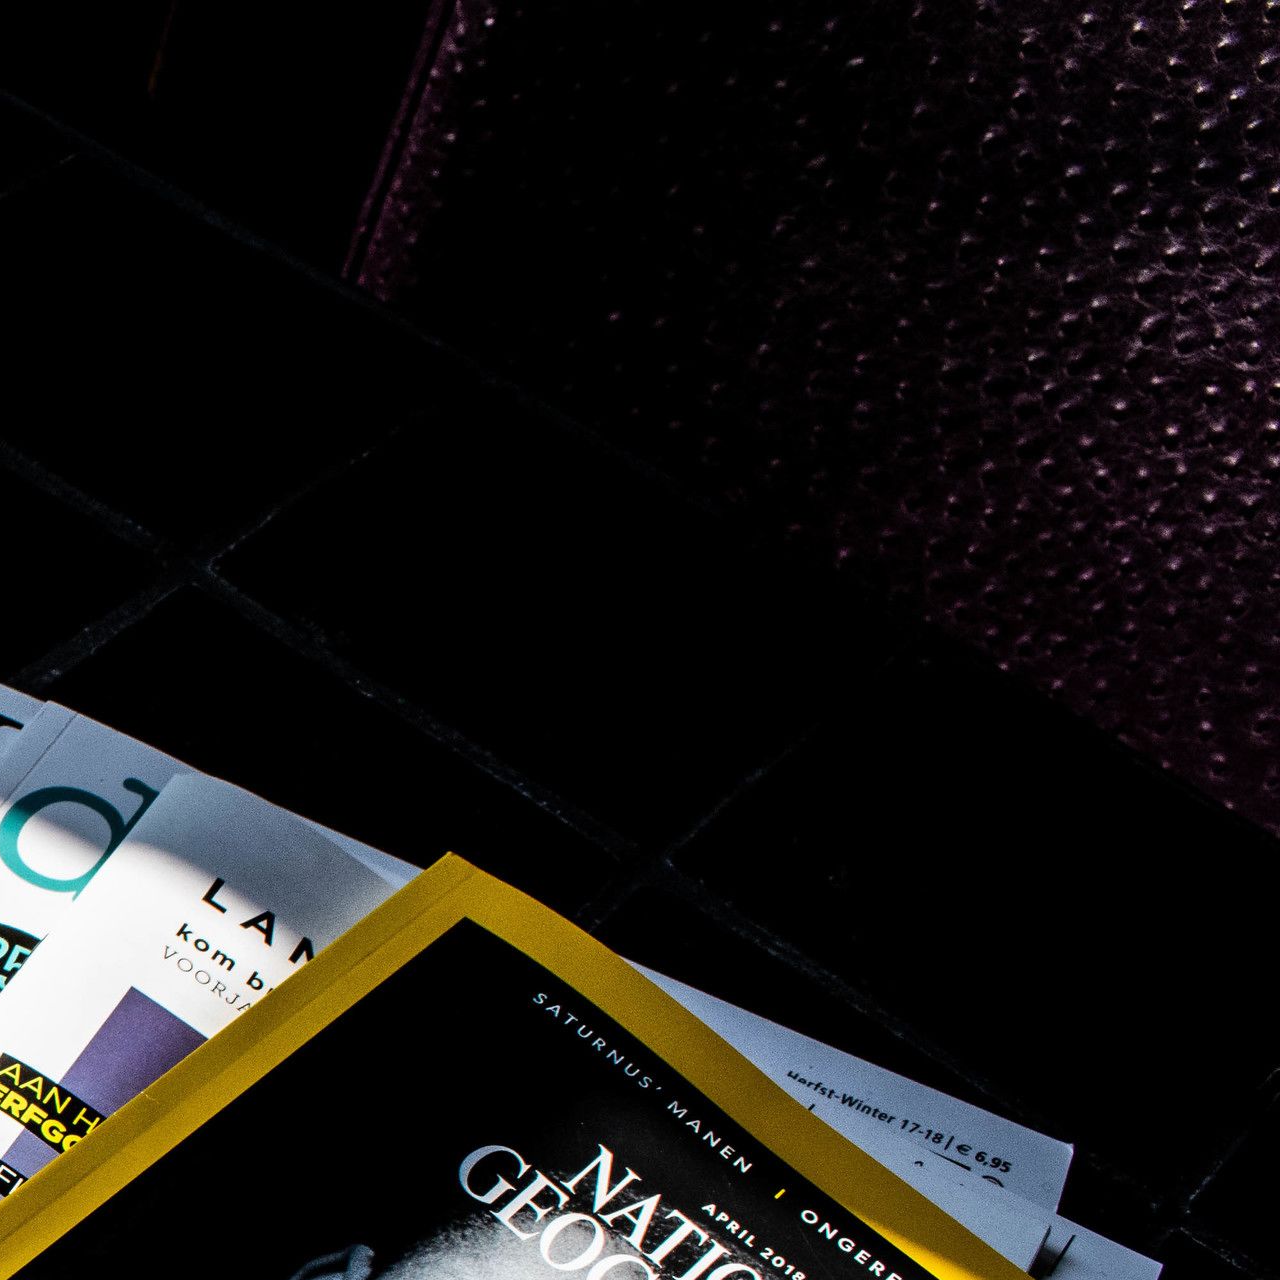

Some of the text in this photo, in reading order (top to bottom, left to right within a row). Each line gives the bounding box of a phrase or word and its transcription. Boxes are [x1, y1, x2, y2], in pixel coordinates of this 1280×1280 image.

[176, 923, 236, 972] kom
[667, 1100, 754, 1176] MANEN
[900, 1118, 944, 1145] 17-18
[974, 1151, 1013, 1174] 6,95
[701, 1203, 757, 1249] APRIL
